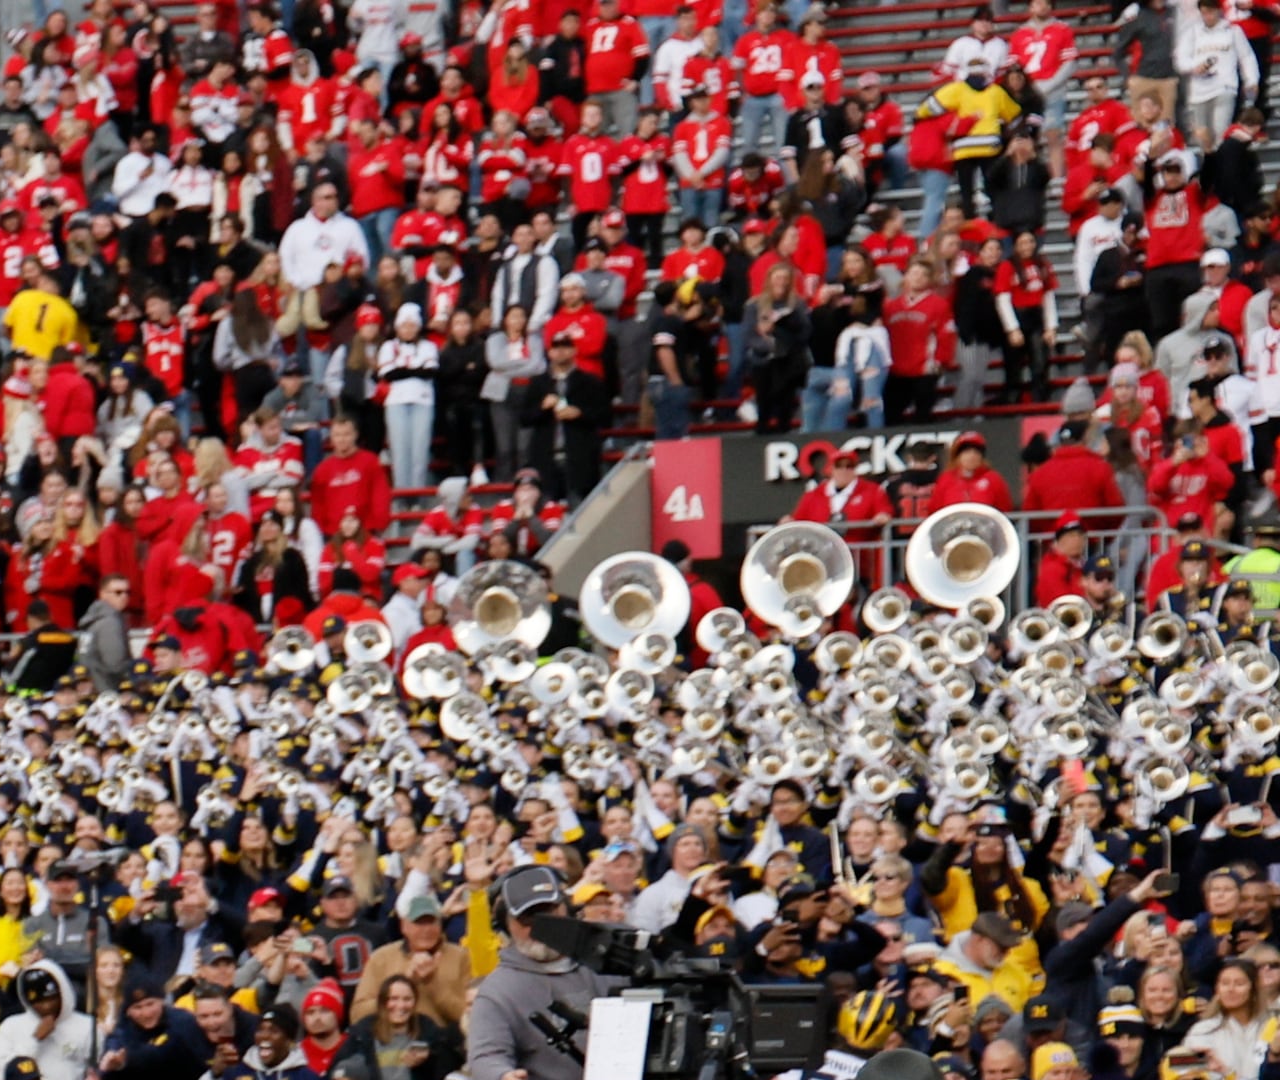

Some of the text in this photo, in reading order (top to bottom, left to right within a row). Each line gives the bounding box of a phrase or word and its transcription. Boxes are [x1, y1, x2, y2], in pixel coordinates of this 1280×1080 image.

[1024, 41, 1047, 74] 7
[301, 92, 316, 123] 1
[693, 130, 708, 160] 1
[806, 117, 826, 148] 1
[581, 152, 602, 182] 0
[3, 246, 23, 278] 2
[35, 303, 49, 332] 1
[765, 431, 960, 482] ROCK
[663, 486, 704, 522] 4A
